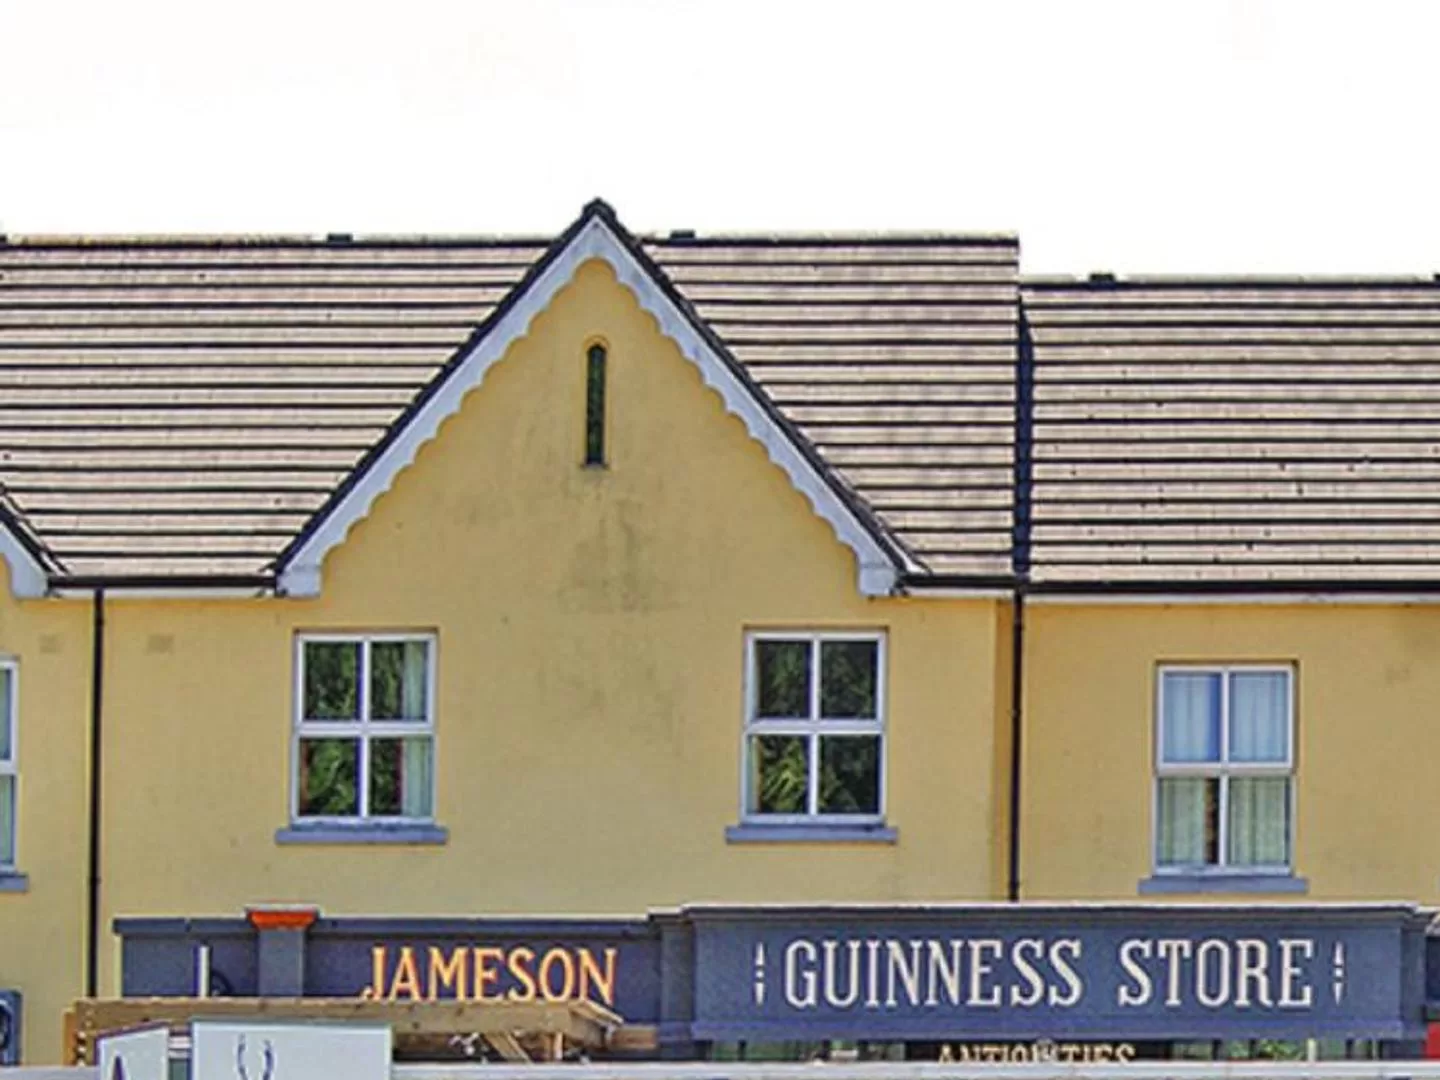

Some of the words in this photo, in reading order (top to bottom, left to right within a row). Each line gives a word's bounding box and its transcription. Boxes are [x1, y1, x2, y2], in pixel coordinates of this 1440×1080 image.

[358, 946, 617, 1005] JAMESON
[785, 938, 1082, 1009] GUINNESS
[1117, 938, 1313, 1009] STORE
